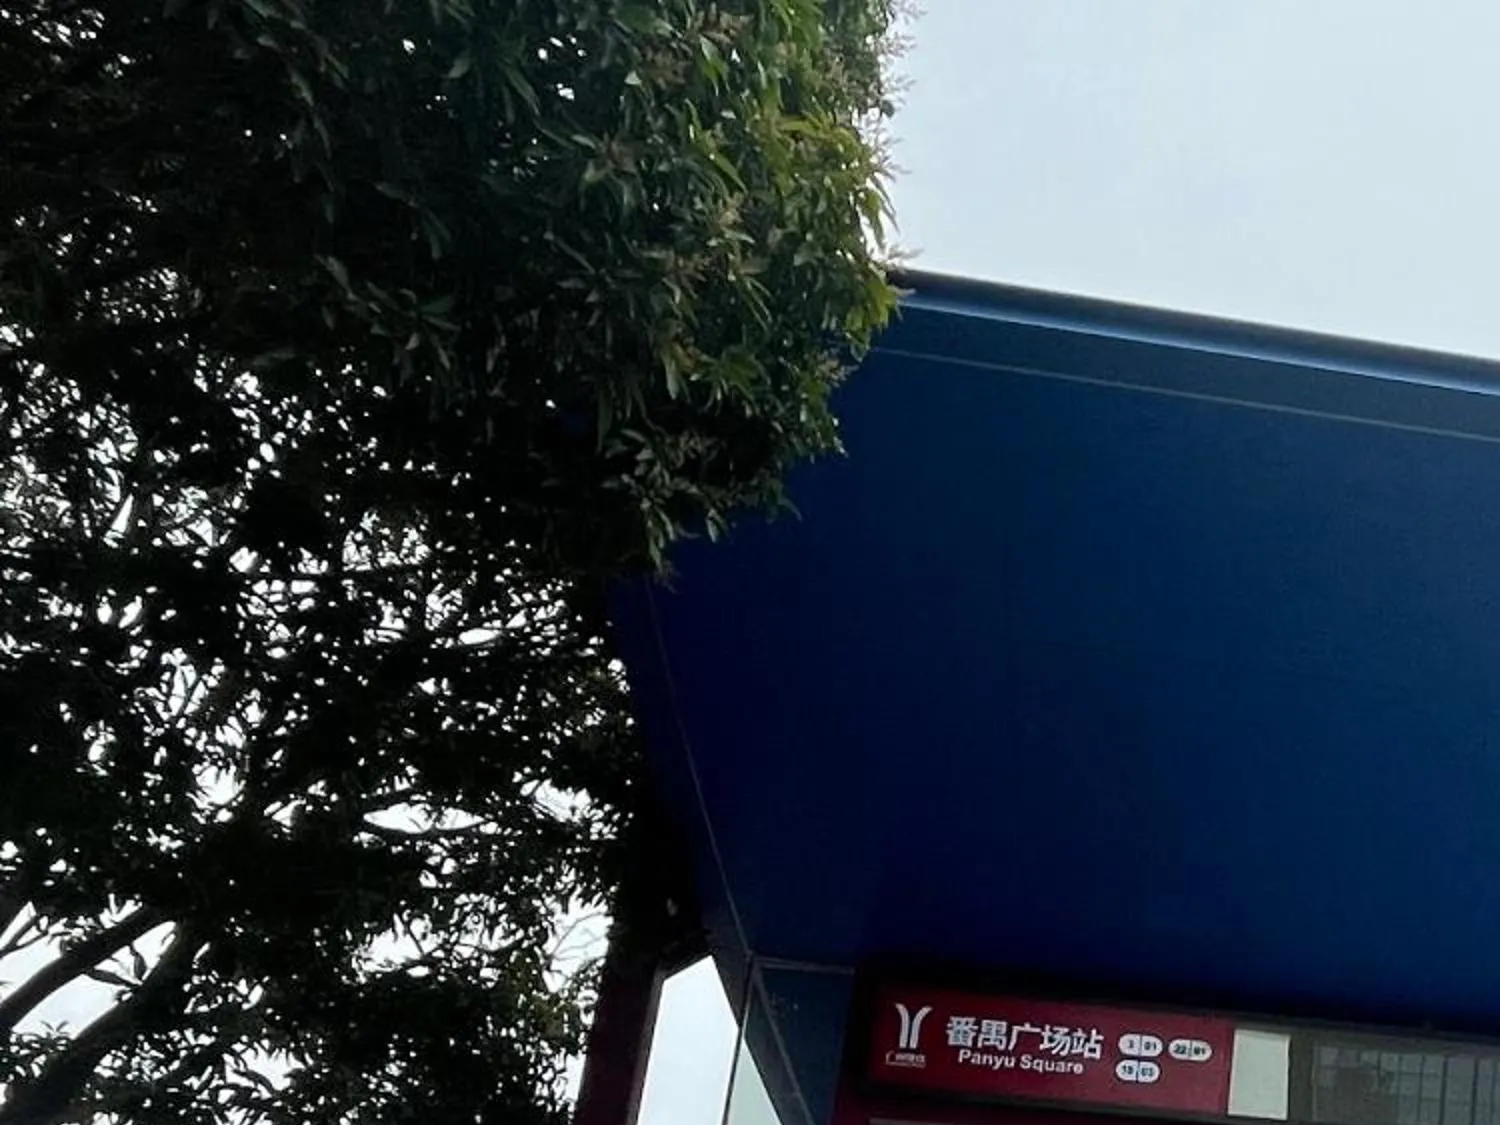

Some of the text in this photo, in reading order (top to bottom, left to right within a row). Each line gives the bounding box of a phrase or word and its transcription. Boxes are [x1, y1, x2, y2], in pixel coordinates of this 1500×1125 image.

[945, 1015, 1105, 1060] 番禺广场站
[957, 1048, 1084, 1074] Panyu Square
